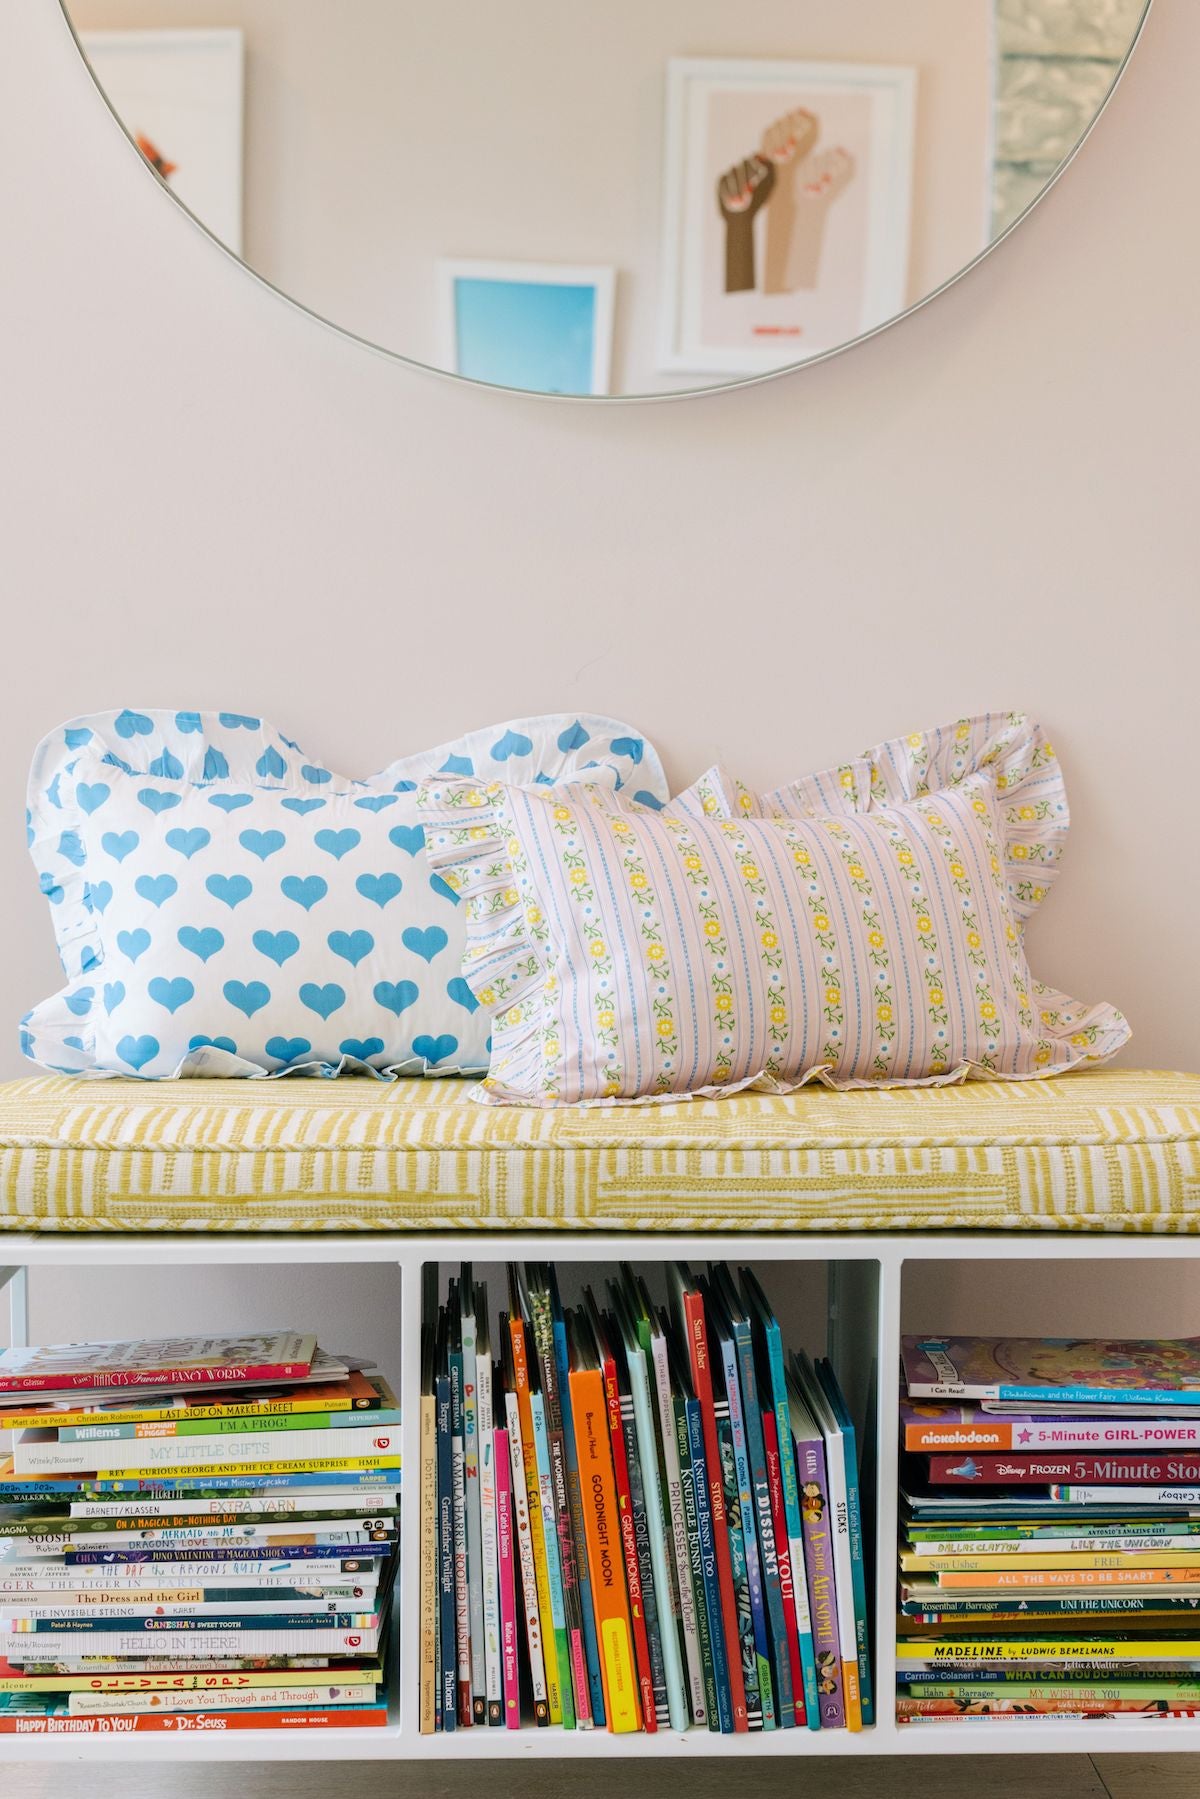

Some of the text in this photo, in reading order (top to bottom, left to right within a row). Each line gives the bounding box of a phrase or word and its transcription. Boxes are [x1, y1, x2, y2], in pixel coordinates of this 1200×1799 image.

[171, 1368, 246, 1381] FANCY WORDS
[1076, 1392, 1096, 1400] Flower
[160, 1410, 180, 1419] LAST
[184, 1408, 206, 1417] STOP
[208, 1406, 222, 1416] ON
[226, 1404, 260, 1414] MARKET
[264, 1403, 293, 1412] STREET
[694, 1318, 724, 1520] Sam Usher STORM
[76, 1418, 287, 1438] Willems I'M A FROG!
[514, 1334, 522, 1354] Dean
[528, 1490, 540, 1510] Cat
[921, 1429, 1196, 1444] nickelodeon 5-Minute GIRL-POWER
[150, 1442, 270, 1460] MY LITTLE GIFTS
[140, 1467, 178, 1476] CURIOUS
[181, 1466, 214, 1474] GEORGE
[218, 1464, 236, 1472] AND
[277, 1462, 306, 1470] CREAM
[308, 1460, 348, 1468] SURPRISE
[995, 1460, 1161, 1480] Disney FROZEN 5-Minute
[176, 1479, 196, 1490] Cat
[554, 1458, 566, 1510] WONDERFUL
[607, 1378, 640, 1598] Lang Lang GRUMPY MONKEY
[691, 1412, 711, 1548] Willems KNUFFLE BUNNY
[86, 1500, 295, 1516] BARNETT/KLASSEN EXTRA YARN
[586, 1412, 613, 1587] Brown/Hurd GOODNIGHT MOON
[116, 1514, 236, 1528] ON MAGICAL DAY
[451, 1366, 468, 1664] GRIMES/FREEMAN KAMALA ROOTED IN JUSTICE
[670, 1482, 686, 1558] PRINCESSES
[28, 1528, 234, 1544] SOOSH MERMAID ME
[423, 1458, 434, 1613] Don't Pigeon Drive
[678, 1416, 708, 1644] Willems KNUFFLE BUNNY CAUTIONARY
[758, 1497, 778, 1576] DISSENT
[129, 1537, 250, 1549] DRAGONS LOVE TACOS
[806, 1450, 835, 1644] CHEN A AWESOME!
[976, 1538, 1172, 1552] CLAYTON LILY UNICORN
[438, 1402, 455, 1711] Berger Grandfather Twilight Philomel
[634, 1512, 653, 1599] STONE SAT STILL
[929, 1558, 1122, 1569] Sam Usher FREE
[778, 1550, 793, 1599] YOU!
[998, 1576, 1018, 1584] ALL
[1024, 1575, 1044, 1583] THE
[1080, 1574, 1094, 1582] TO
[1118, 1572, 1154, 1580] SMART
[76, 1592, 200, 1603] The Dress and the Girl
[836, 1502, 858, 1700] STICKS ALBER
[922, 1600, 1144, 1610] Rosenthal Barrager UNI THE UNICORN
[50, 1608, 96, 1616] INVISIBLE
[100, 1608, 134, 1616] STRING
[856, 1620, 864, 1642] Wallace
[120, 1637, 240, 1650] HELLO IN THERE!
[934, 1646, 1003, 1656] MADELINE
[904, 1672, 934, 1680] Carrino
[940, 1672, 974, 1680] Colaneri
[1005, 1672, 1037, 1680] WHAT
[1041, 1671, 1064, 1680] CAN
[1070, 1671, 1090, 1680] YOU
[1093, 1671, 1110, 1679] DO
[762, 1664, 772, 1712] GIBBS SMITH
[924, 1688, 1120, 1698] Hahn Barrager MY WISH FOR YOU
[218, 1691, 318, 1704] Through and Through
[16, 1719, 47, 1732] HAPPY
[48, 1718, 94, 1732] BIRTHDAY
[108, 1716, 138, 1732] YOU!
[176, 1717, 194, 1730] Dr.
[196, 1714, 226, 1729] Seuss
